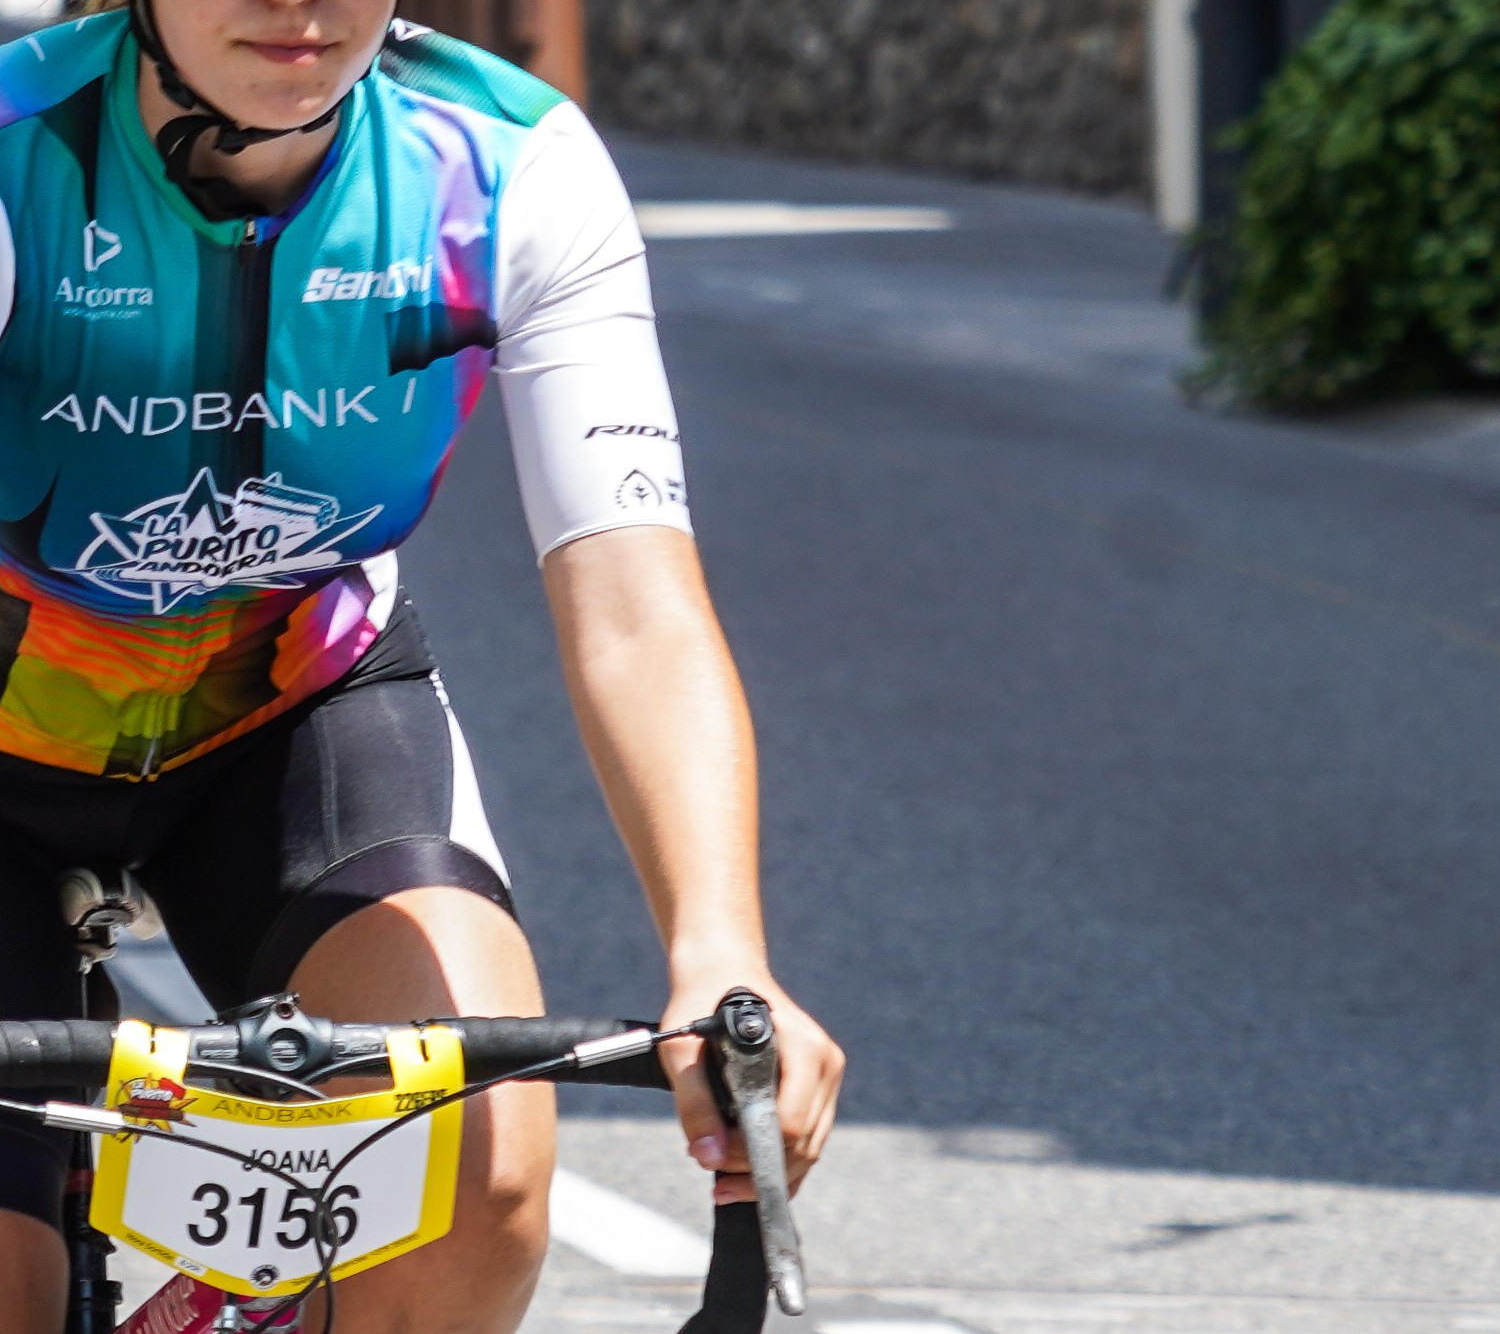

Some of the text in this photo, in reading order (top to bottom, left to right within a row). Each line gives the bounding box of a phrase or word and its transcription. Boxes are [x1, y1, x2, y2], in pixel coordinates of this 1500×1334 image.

[40, 384, 380, 437] ANDBANK
[147, 515, 182, 537] LA
[143, 523, 282, 562] PURITO
[212, 1098, 354, 1124] ANDBANK
[242, 1149, 334, 1174] JOANA
[187, 1182, 361, 1250] 3156
